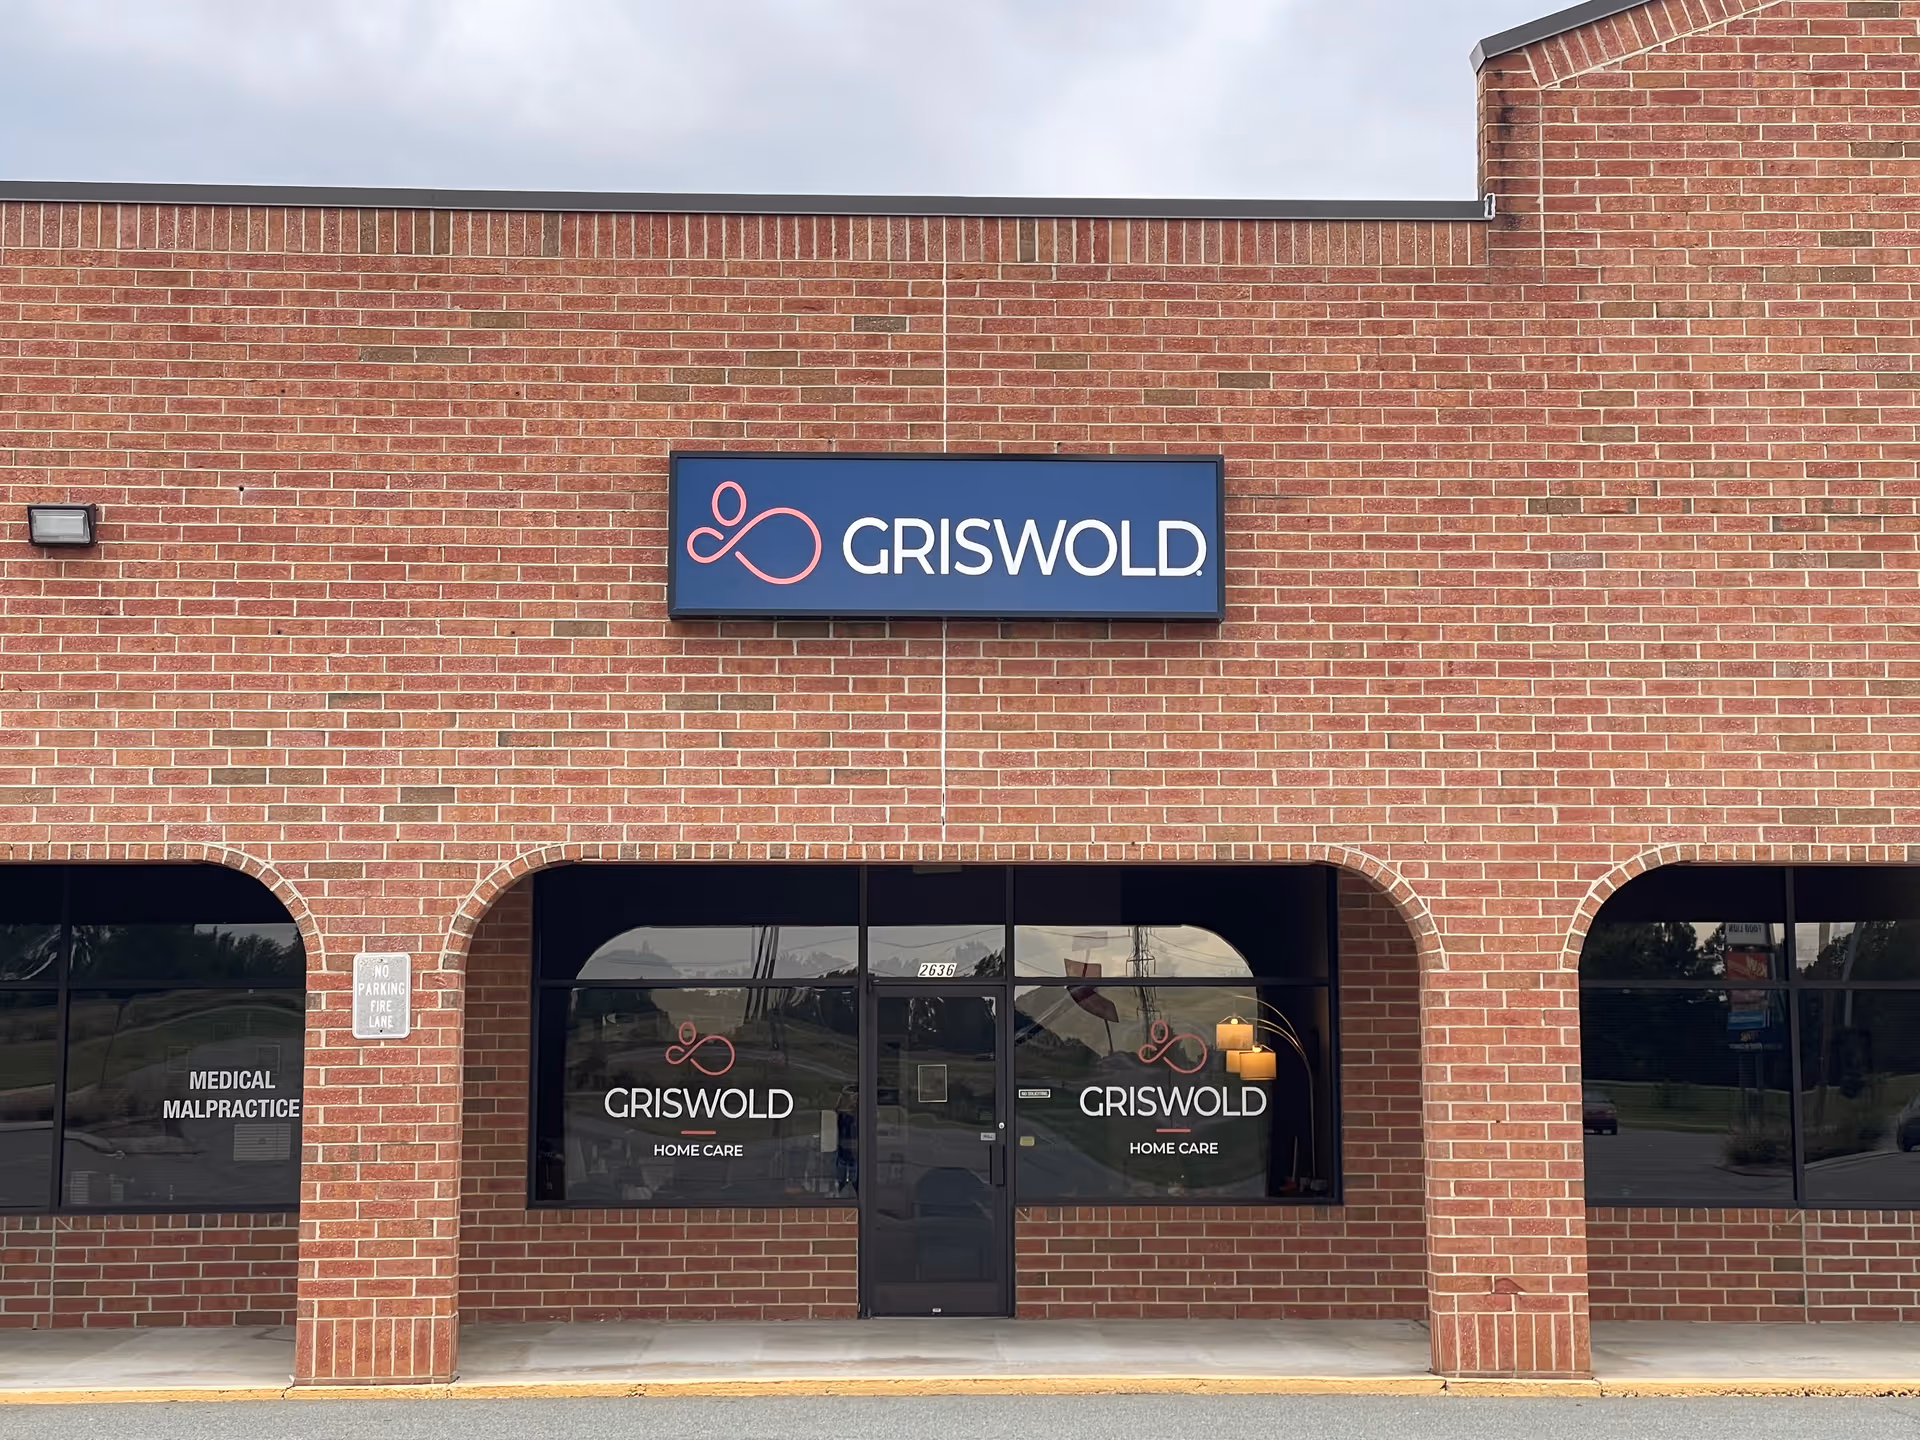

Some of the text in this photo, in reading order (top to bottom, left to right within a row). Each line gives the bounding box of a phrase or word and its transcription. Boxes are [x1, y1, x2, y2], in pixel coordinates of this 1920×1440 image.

[374, 964, 389, 978] NO
[919, 964, 955, 976] 2636
[358, 982, 405, 996] PARKING
[370, 1000, 393, 1012] FIRE
[369, 1015, 394, 1028] LANE
[189, 1070, 276, 1090] MEDICAL
[604, 1087, 794, 1119] GRISWOLD
[1079, 1086, 1267, 1117] GRISWOLD
[163, 1099, 300, 1119] MALPRACTICE
[654, 1144, 743, 1157] HOME CARE
[1130, 1142, 1219, 1155] HOME CARE
